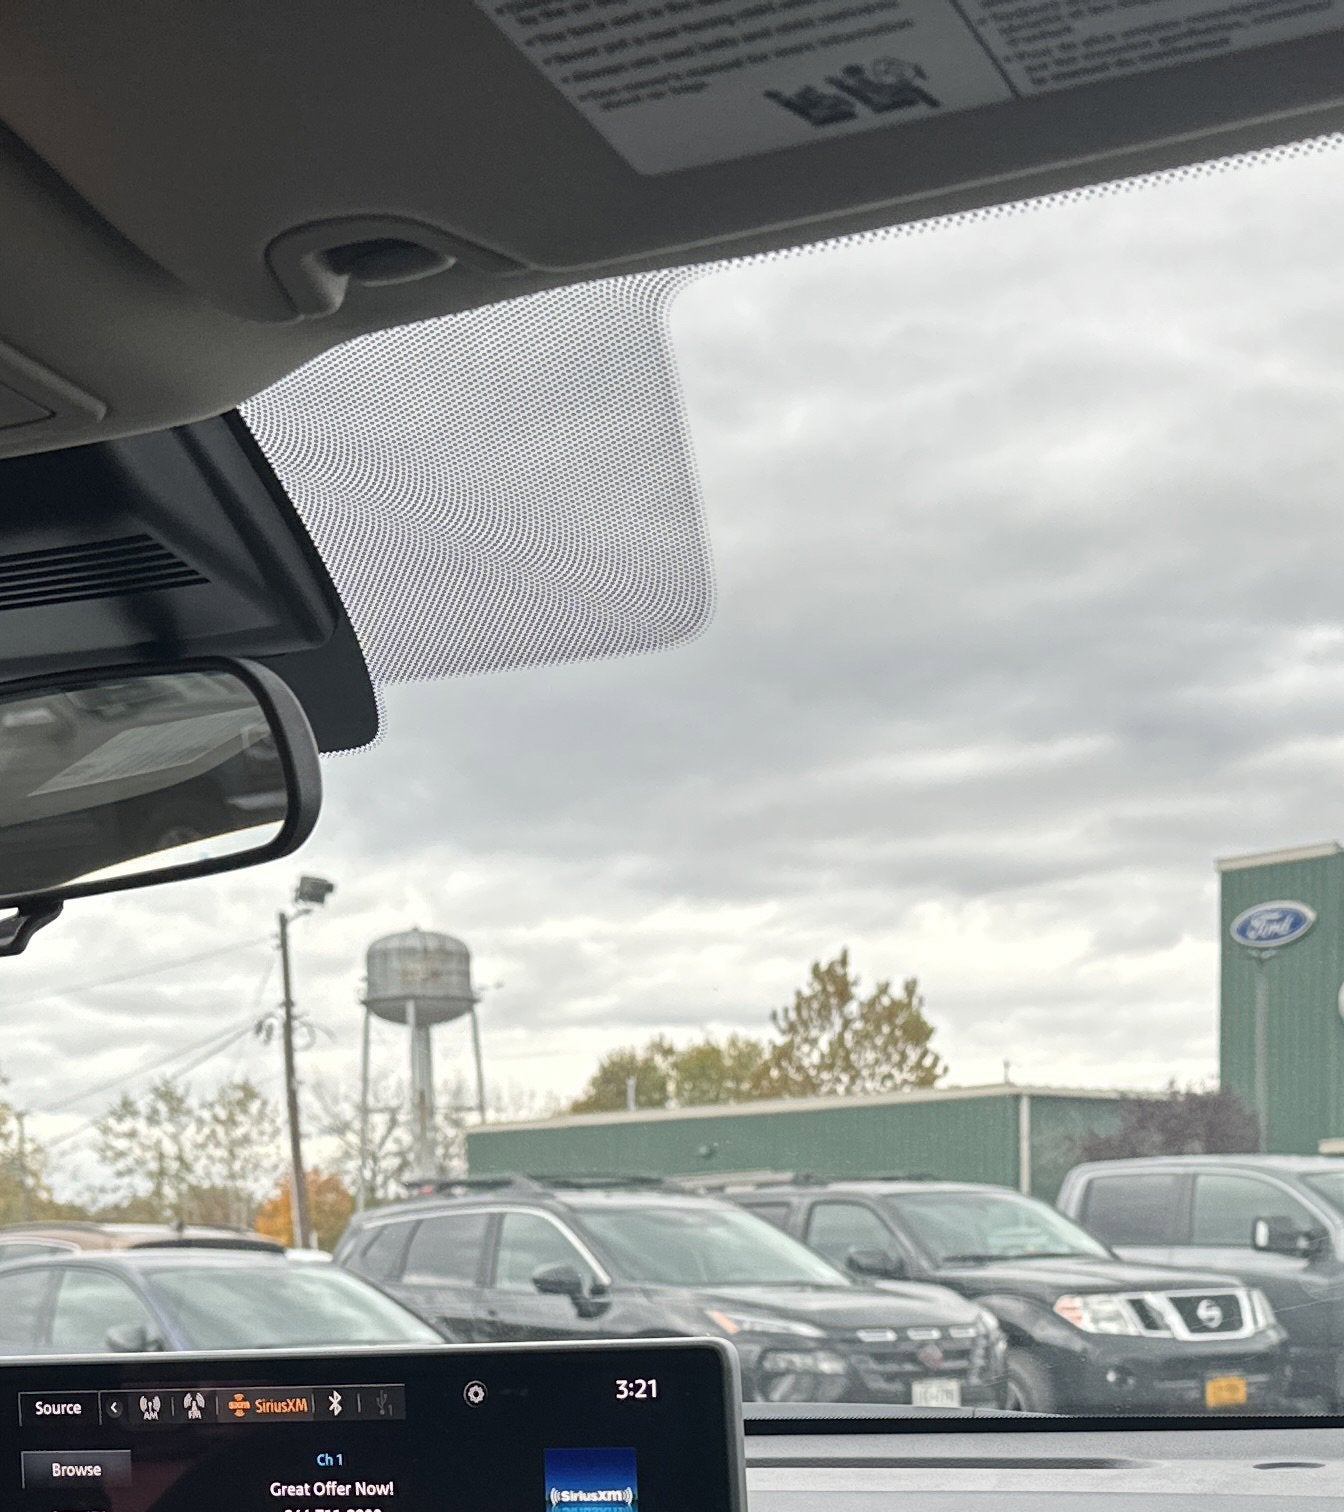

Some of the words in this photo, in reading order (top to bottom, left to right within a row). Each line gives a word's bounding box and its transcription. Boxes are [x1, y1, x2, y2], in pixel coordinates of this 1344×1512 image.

[1245, 910, 1295, 939] Ford
[615, 1379, 658, 1400] 3:21
[35, 1401, 82, 1415] Source
[255, 1397, 308, 1414] SiriusXM
[316, 1453, 333, 1468] Ch
[337, 1453, 344, 1467] 1
[51, 1463, 102, 1478] Browse
[269, 1482, 310, 1498] Great
[313, 1481, 352, 1497] Offer
[355, 1481, 394, 1496] Now!
